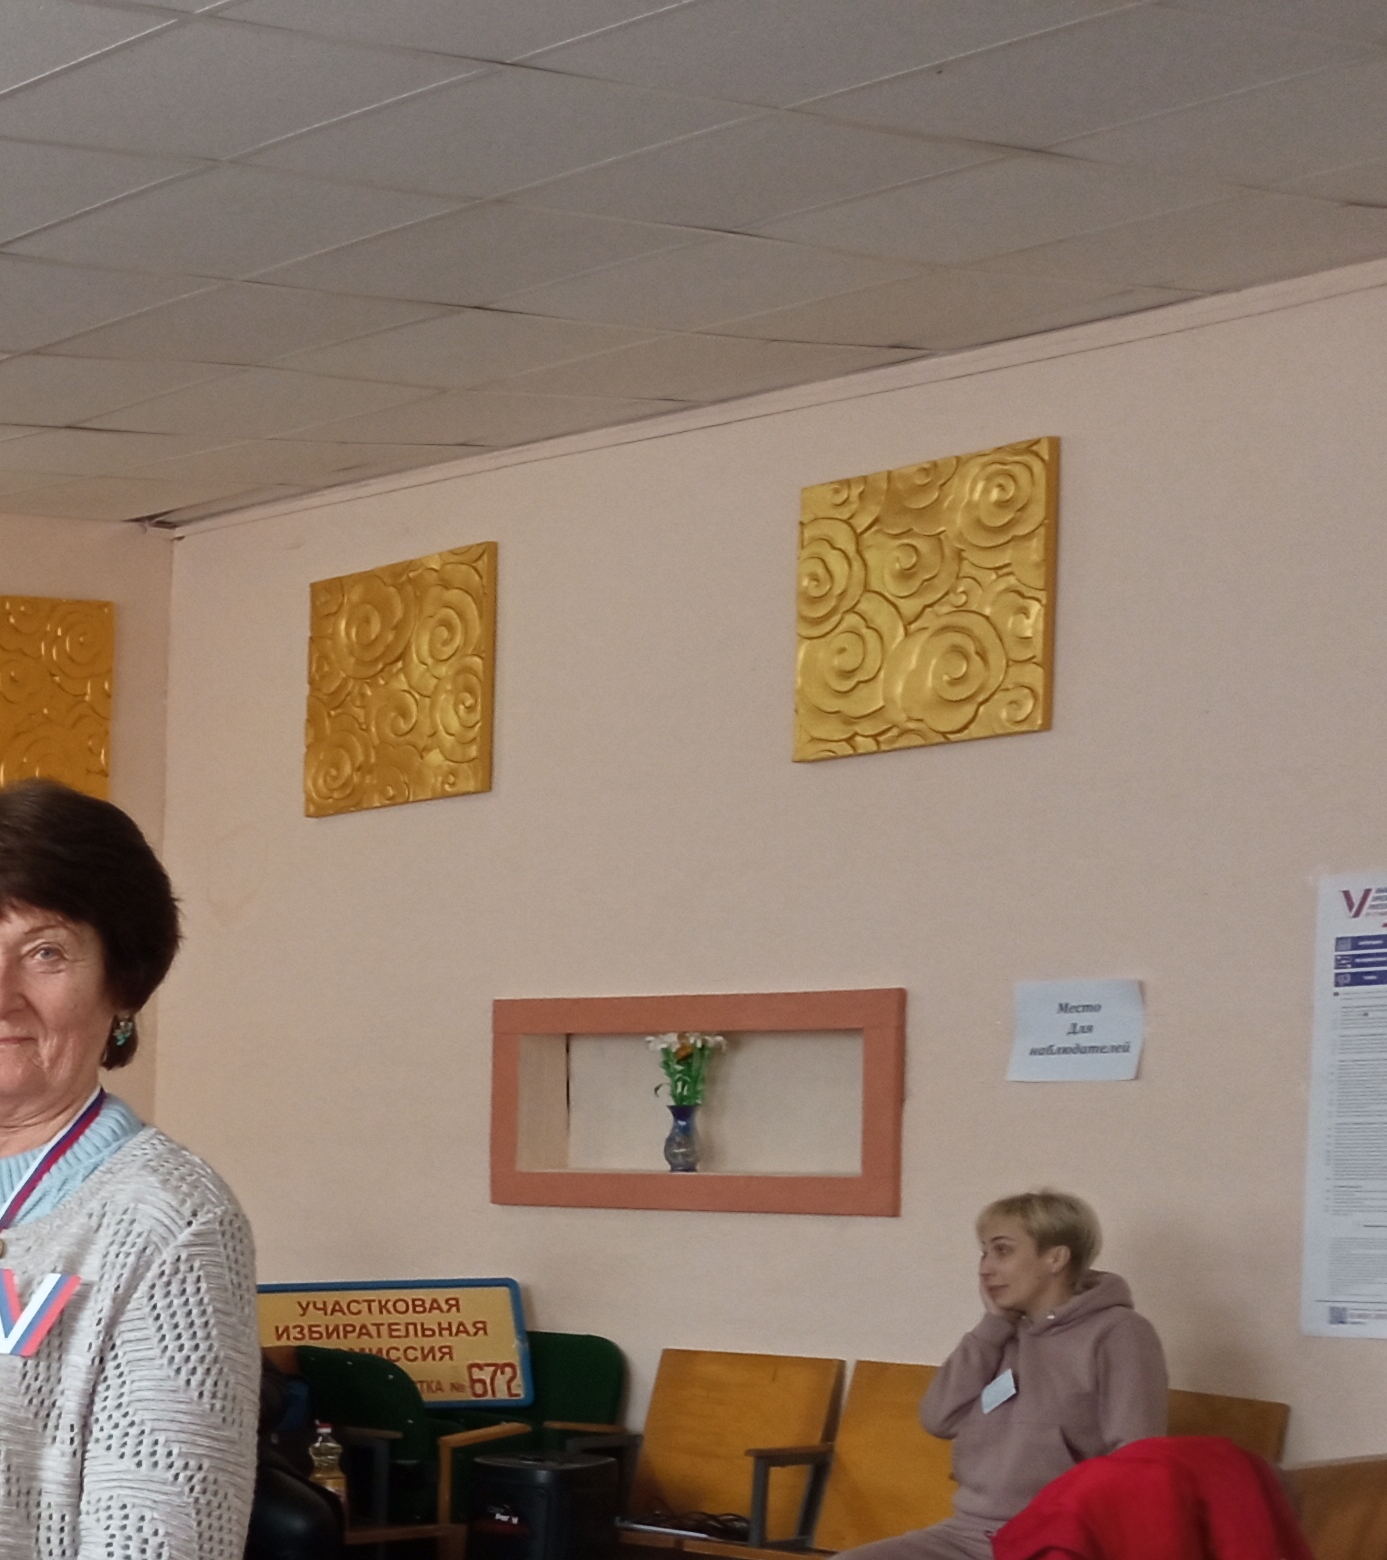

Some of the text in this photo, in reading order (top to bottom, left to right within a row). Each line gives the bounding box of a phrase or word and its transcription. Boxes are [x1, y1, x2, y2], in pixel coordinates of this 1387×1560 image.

[1057, 1002, 1102, 1014] Место
[1066, 1023, 1094, 1035] Для
[1029, 1042, 1131, 1056] наблюдателей
[297, 1297, 461, 1317] УЧАСТКОВАЯ
[275, 1320, 488, 1342] ИЗБИРАТЕЛЬНАЯ
[467, 1362, 521, 1398] 672
